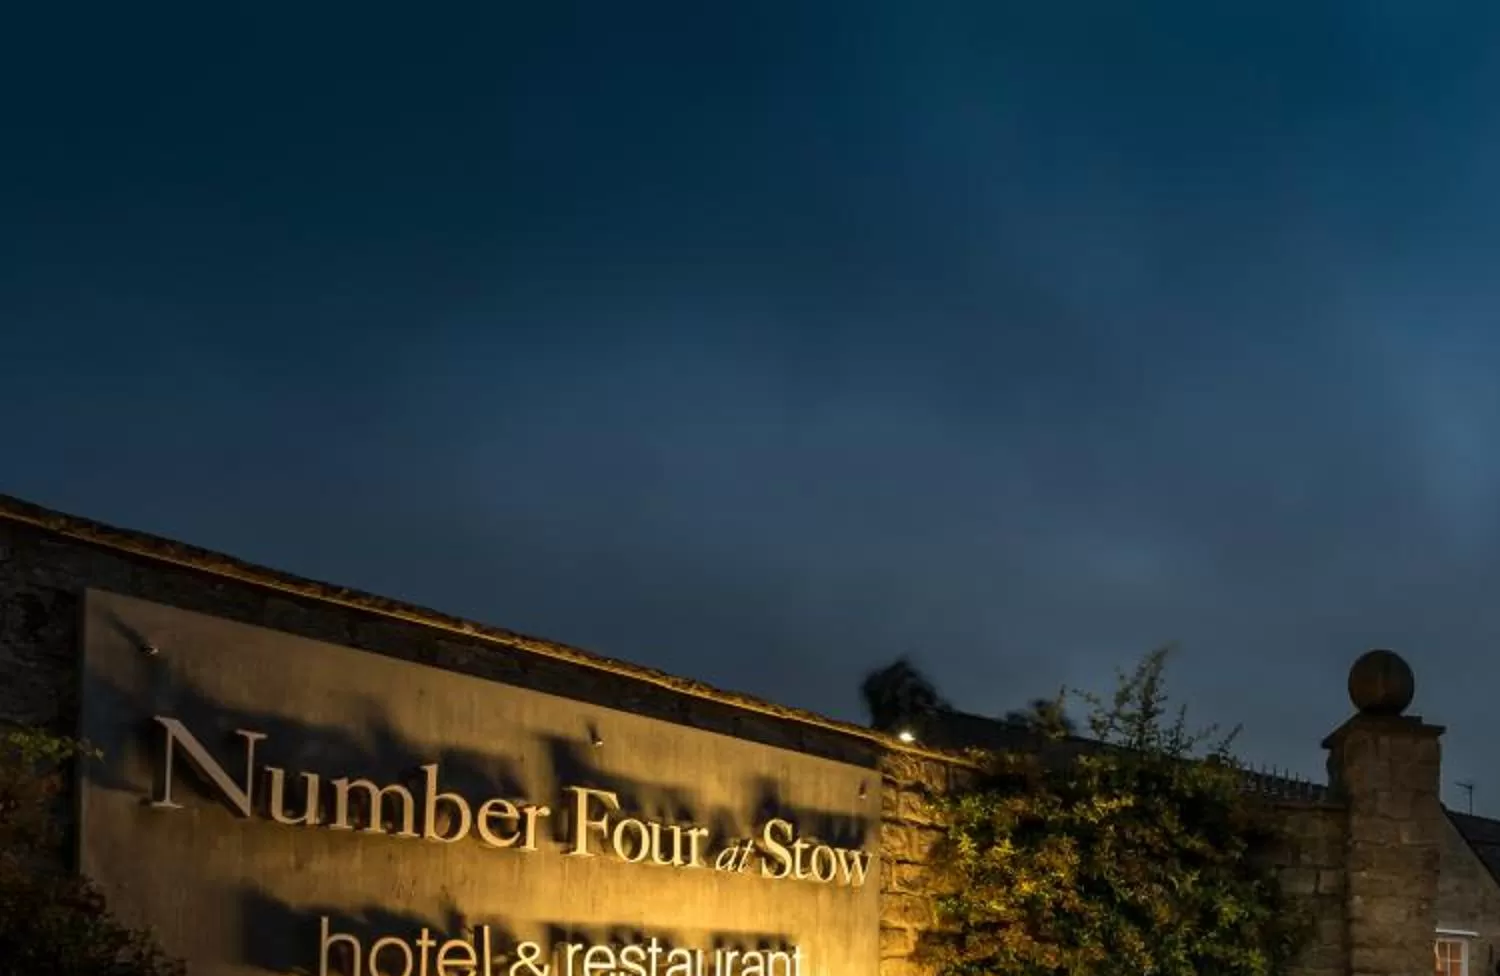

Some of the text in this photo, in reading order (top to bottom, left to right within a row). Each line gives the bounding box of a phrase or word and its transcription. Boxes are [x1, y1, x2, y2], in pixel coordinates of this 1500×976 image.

[152, 714, 873, 886] Number Four at Stow
